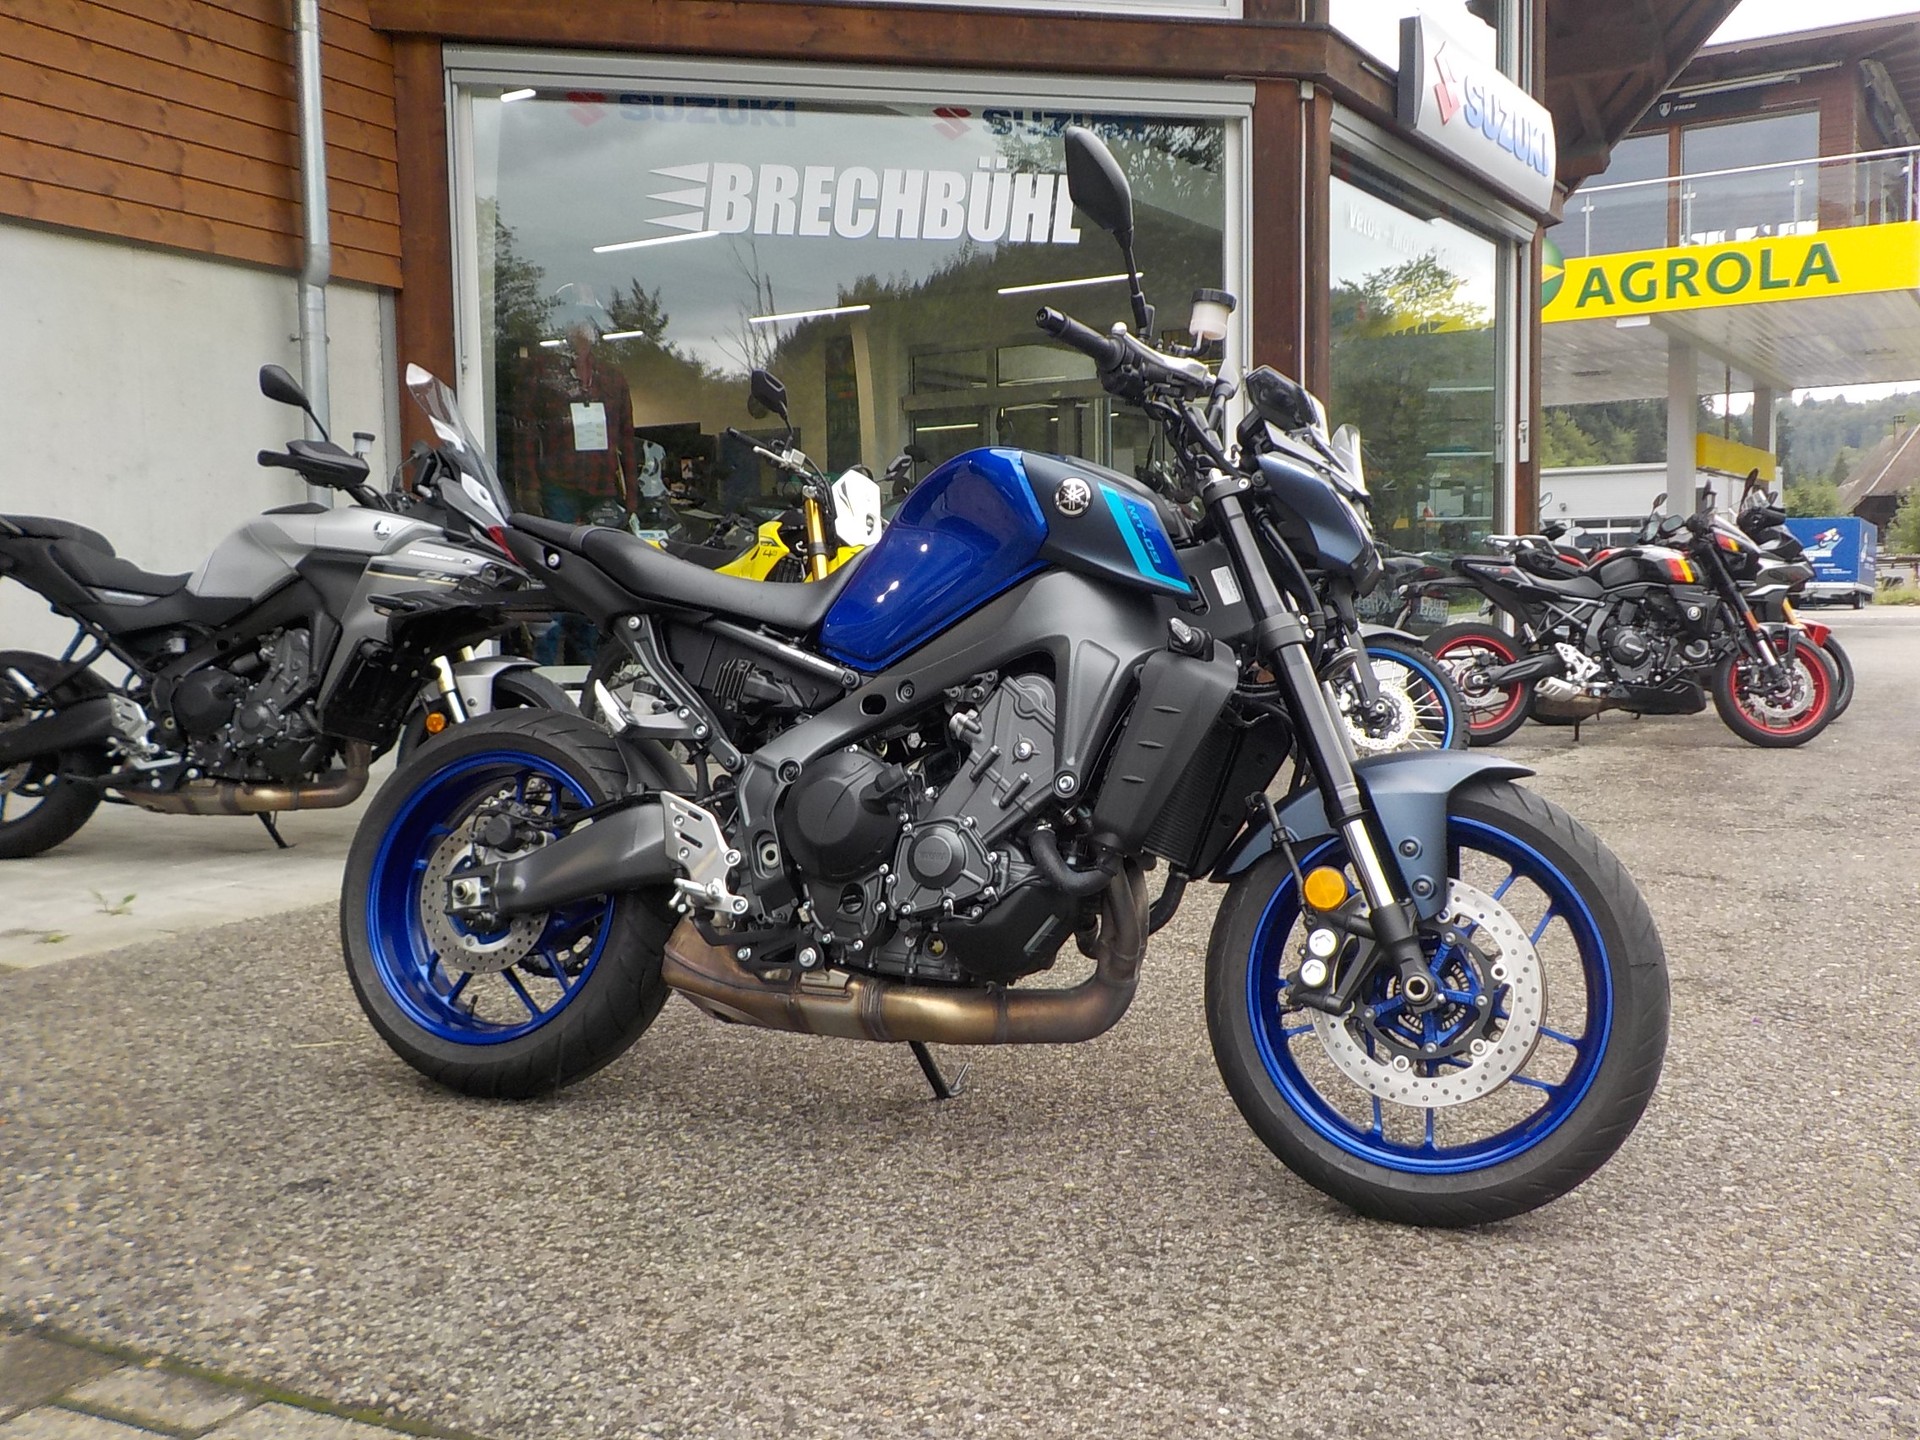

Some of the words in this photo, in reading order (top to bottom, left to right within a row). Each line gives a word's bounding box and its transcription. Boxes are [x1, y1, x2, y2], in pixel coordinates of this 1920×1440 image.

[619, 93, 797, 128] SUZUKI
[1463, 75, 1550, 178] SUZUKI
[706, 155, 1082, 244] BRECHBÜHL
[1575, 242, 1841, 309] AGROLA
[1127, 504, 1161, 565] MT-09
